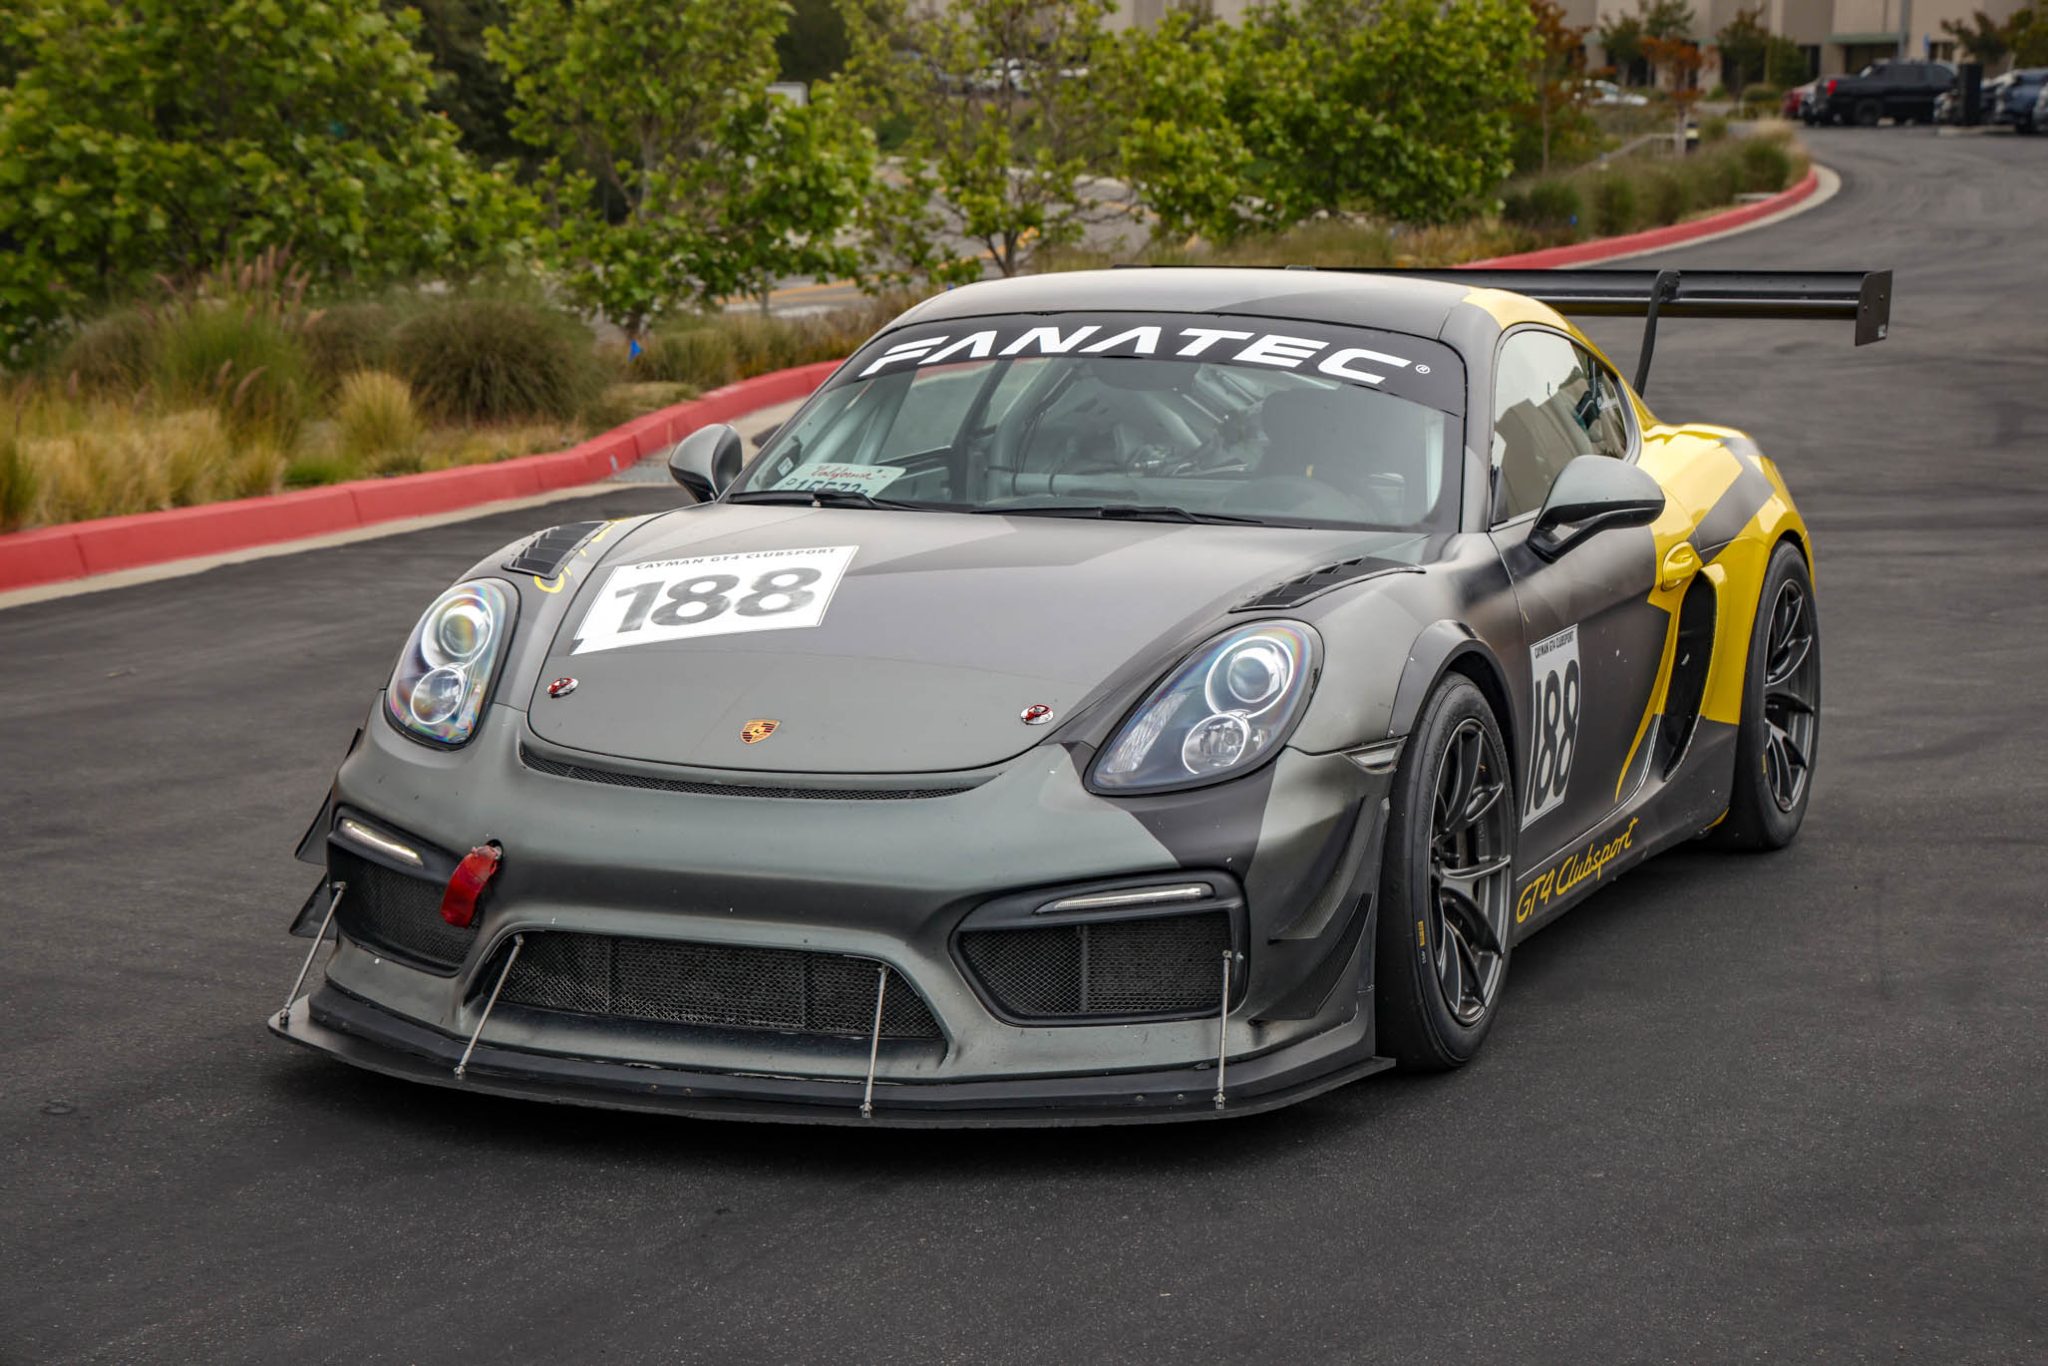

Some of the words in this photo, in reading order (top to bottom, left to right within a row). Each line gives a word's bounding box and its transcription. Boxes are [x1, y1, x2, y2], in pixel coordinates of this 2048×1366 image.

[615, 567, 822, 633] 188
[635, 558, 704, 570] CAYMAN
[711, 554, 740, 562] GT4
[746, 548, 837, 560] CLUBSPORT
[1525, 659, 1580, 816] 188
[1516, 868, 1555, 924] GT4
[1556, 817, 1638, 895] Clubsport
